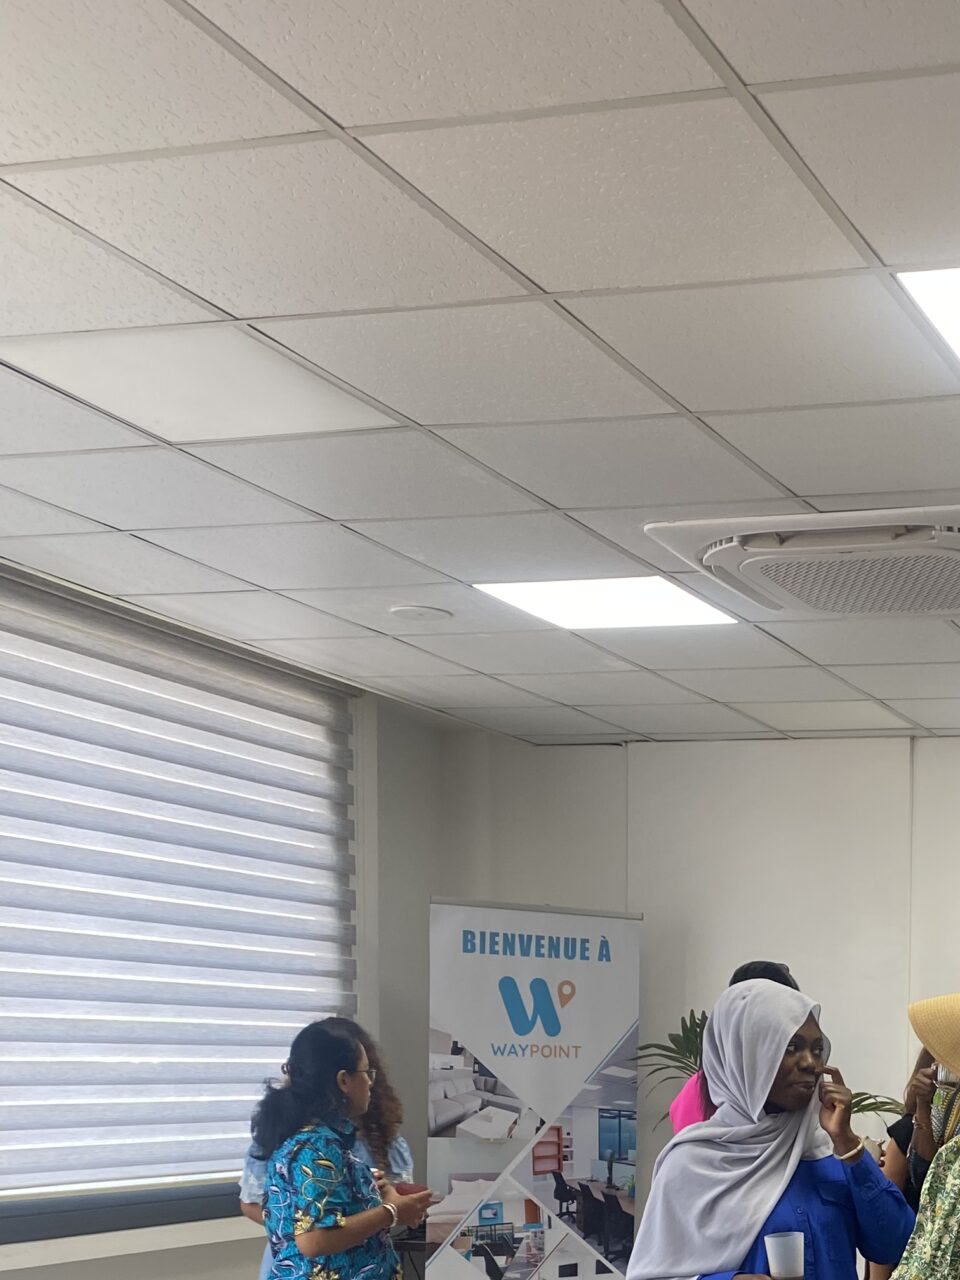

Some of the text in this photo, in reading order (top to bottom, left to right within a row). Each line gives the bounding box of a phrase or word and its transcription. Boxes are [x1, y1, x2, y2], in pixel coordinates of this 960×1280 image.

[462, 930, 611, 962] BIENVENUE À
[490, 1043, 582, 1059] WAYPOINT
